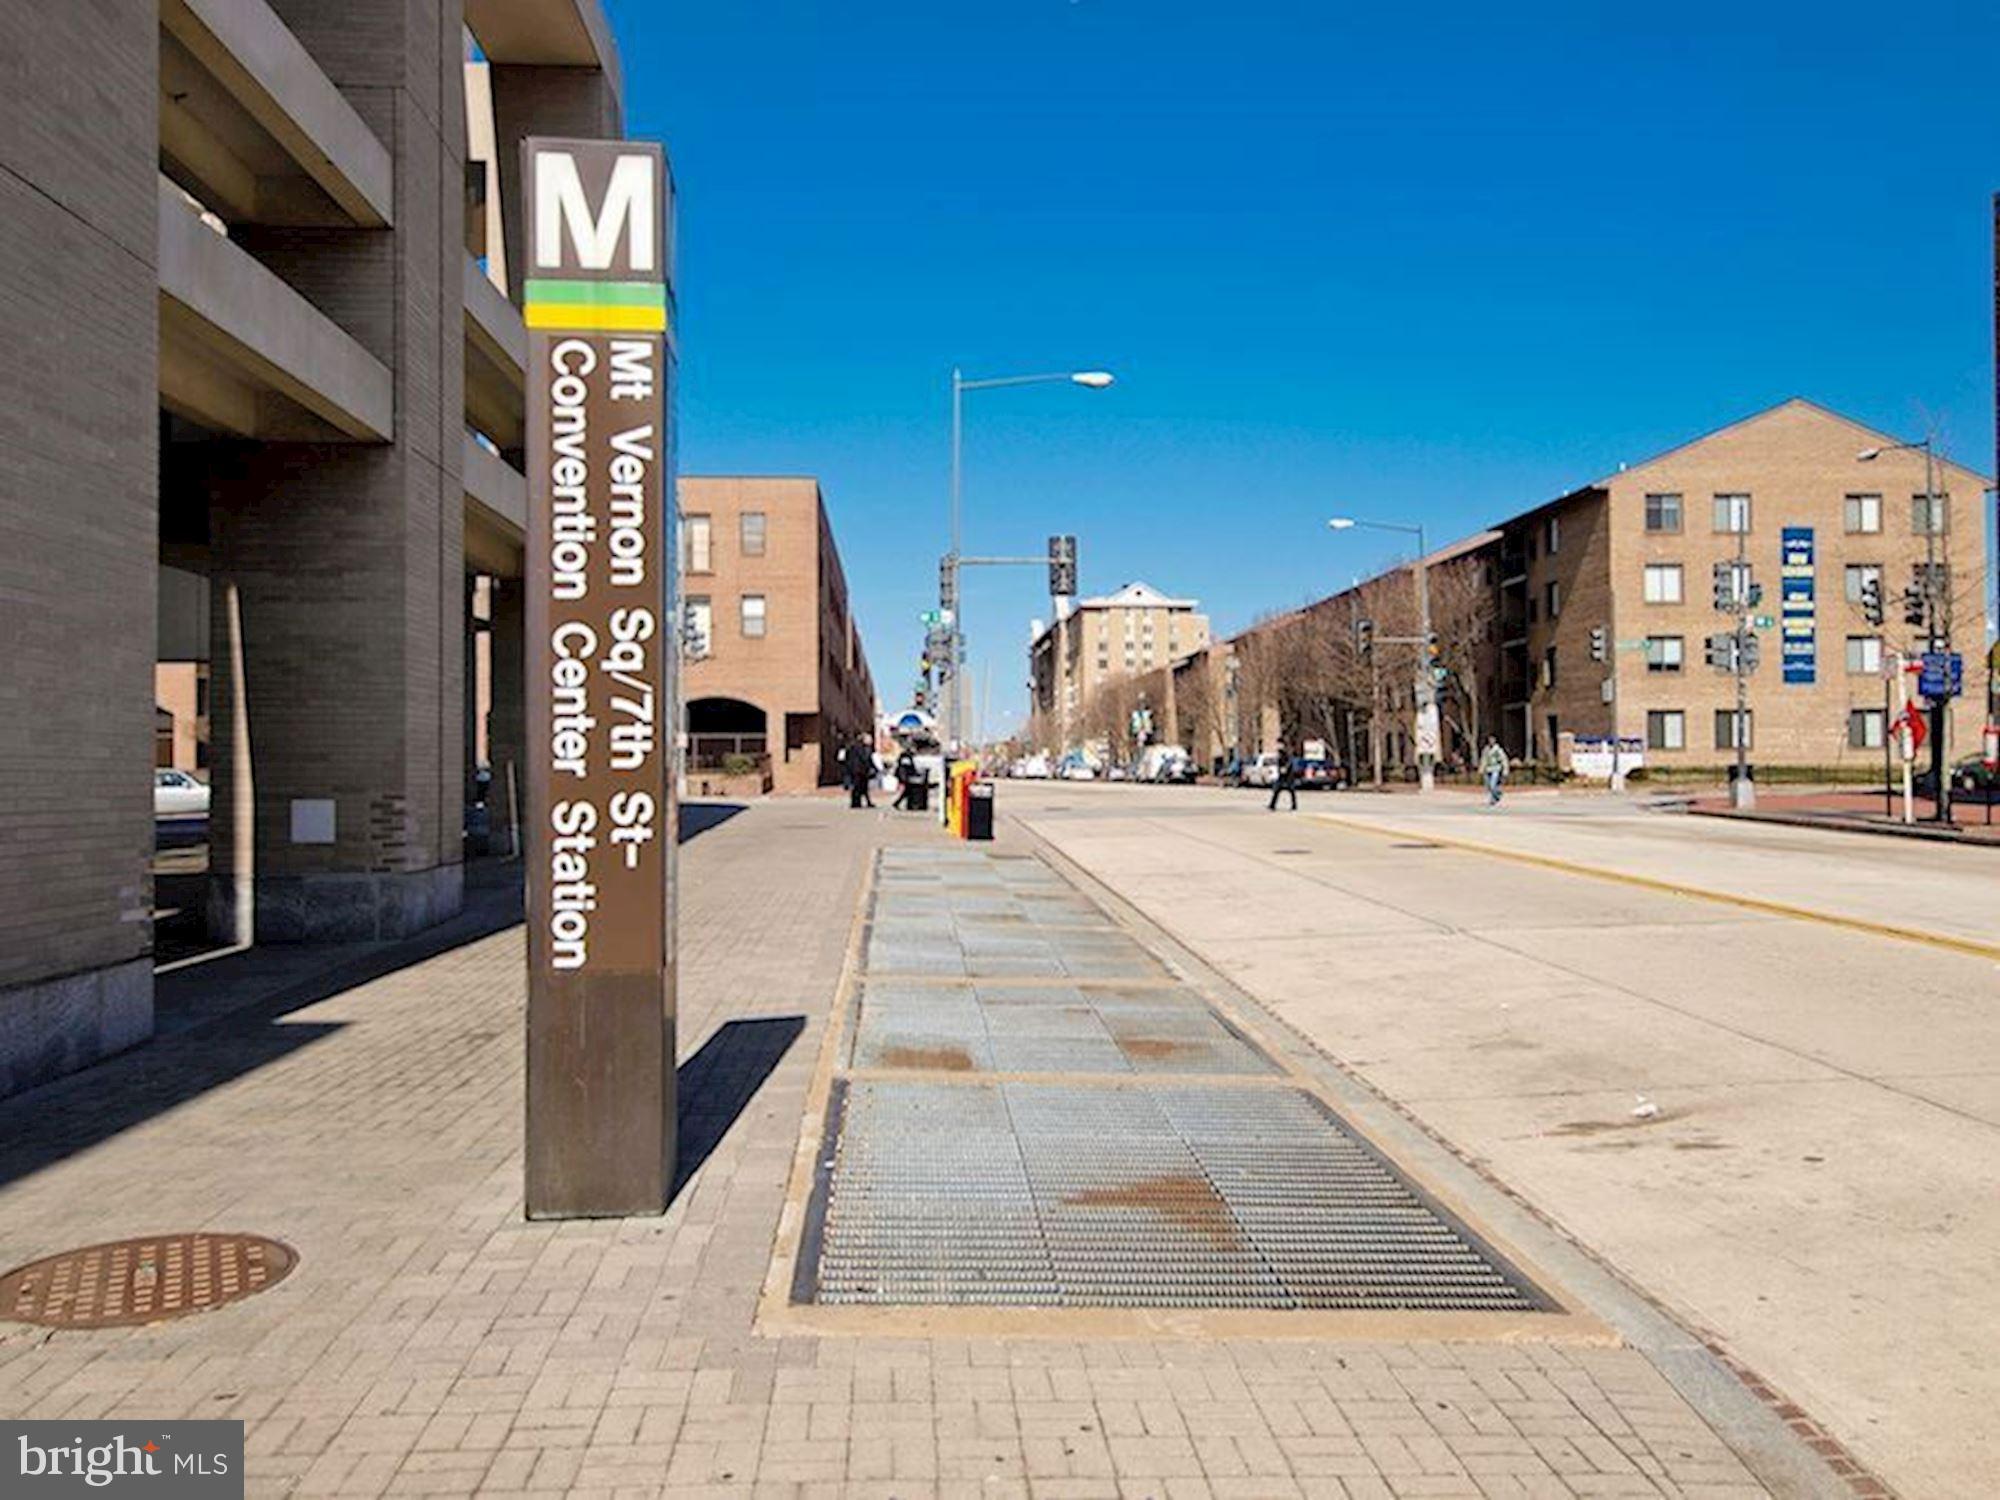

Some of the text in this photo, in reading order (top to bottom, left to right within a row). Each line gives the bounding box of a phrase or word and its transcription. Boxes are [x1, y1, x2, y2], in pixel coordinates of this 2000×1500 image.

[535, 151, 654, 271] M
[551, 339, 598, 970] Convention Center Station
[601, 341, 655, 869] Mt Vernon Sq/7th St-
